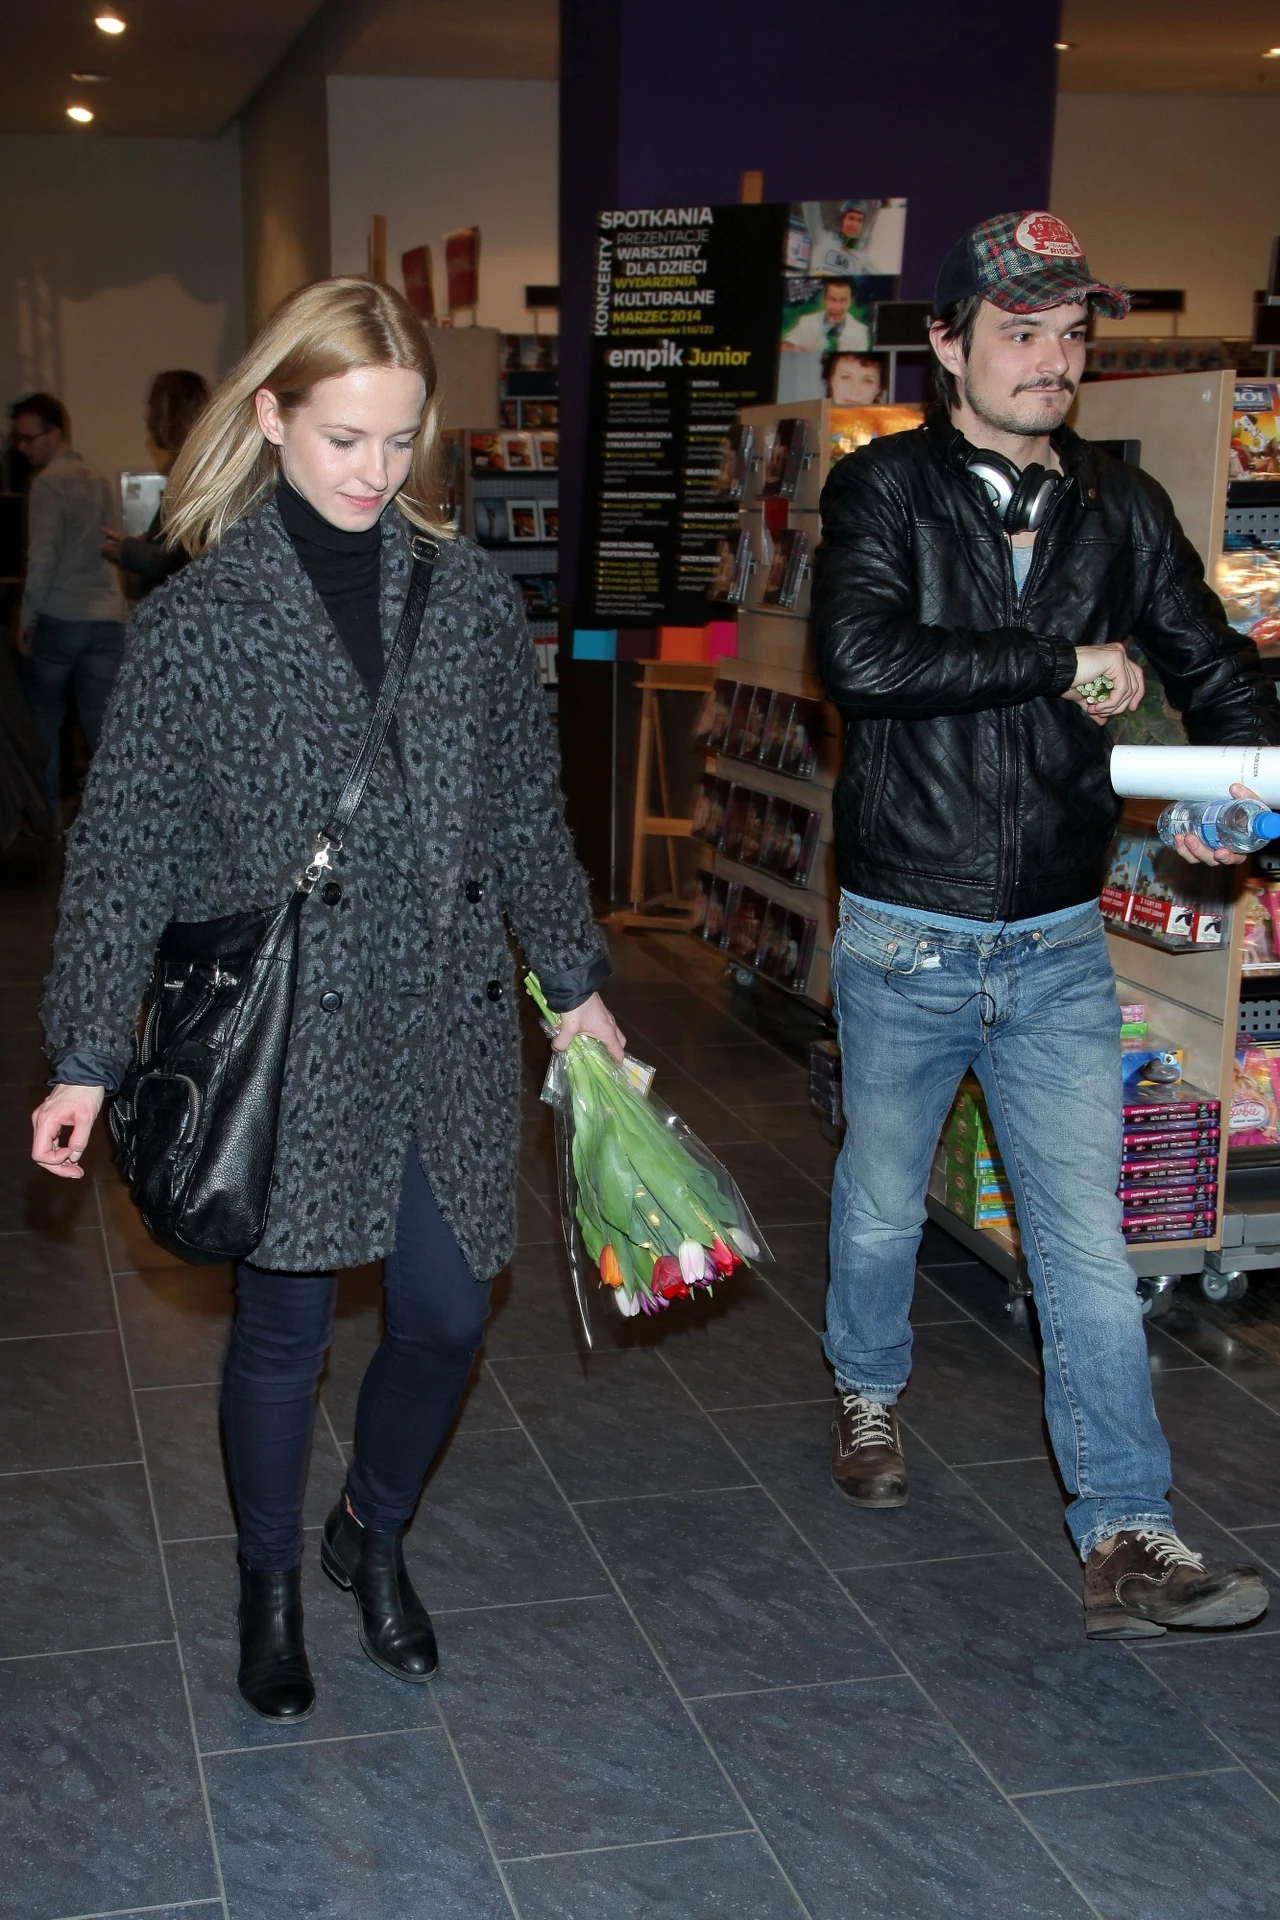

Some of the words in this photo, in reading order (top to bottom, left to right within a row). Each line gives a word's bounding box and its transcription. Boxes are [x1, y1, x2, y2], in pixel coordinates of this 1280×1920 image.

[601, 206, 713, 229] SPOTKANIA
[616, 229, 710, 245] PREZENTACJE
[616, 245, 701, 261] WARSZTATY
[626, 261, 656, 276] DLA
[659, 260, 708, 275] DZIECI
[594, 236, 613, 336] KONCERTY
[614, 276, 697, 289] WYDARZENIA
[613, 290, 716, 307] KULTURALNE
[613, 310, 668, 323] MARZEC
[670, 309, 702, 323] 2014
[608, 339, 684, 371] empik
[687, 346, 752, 367] Junior
